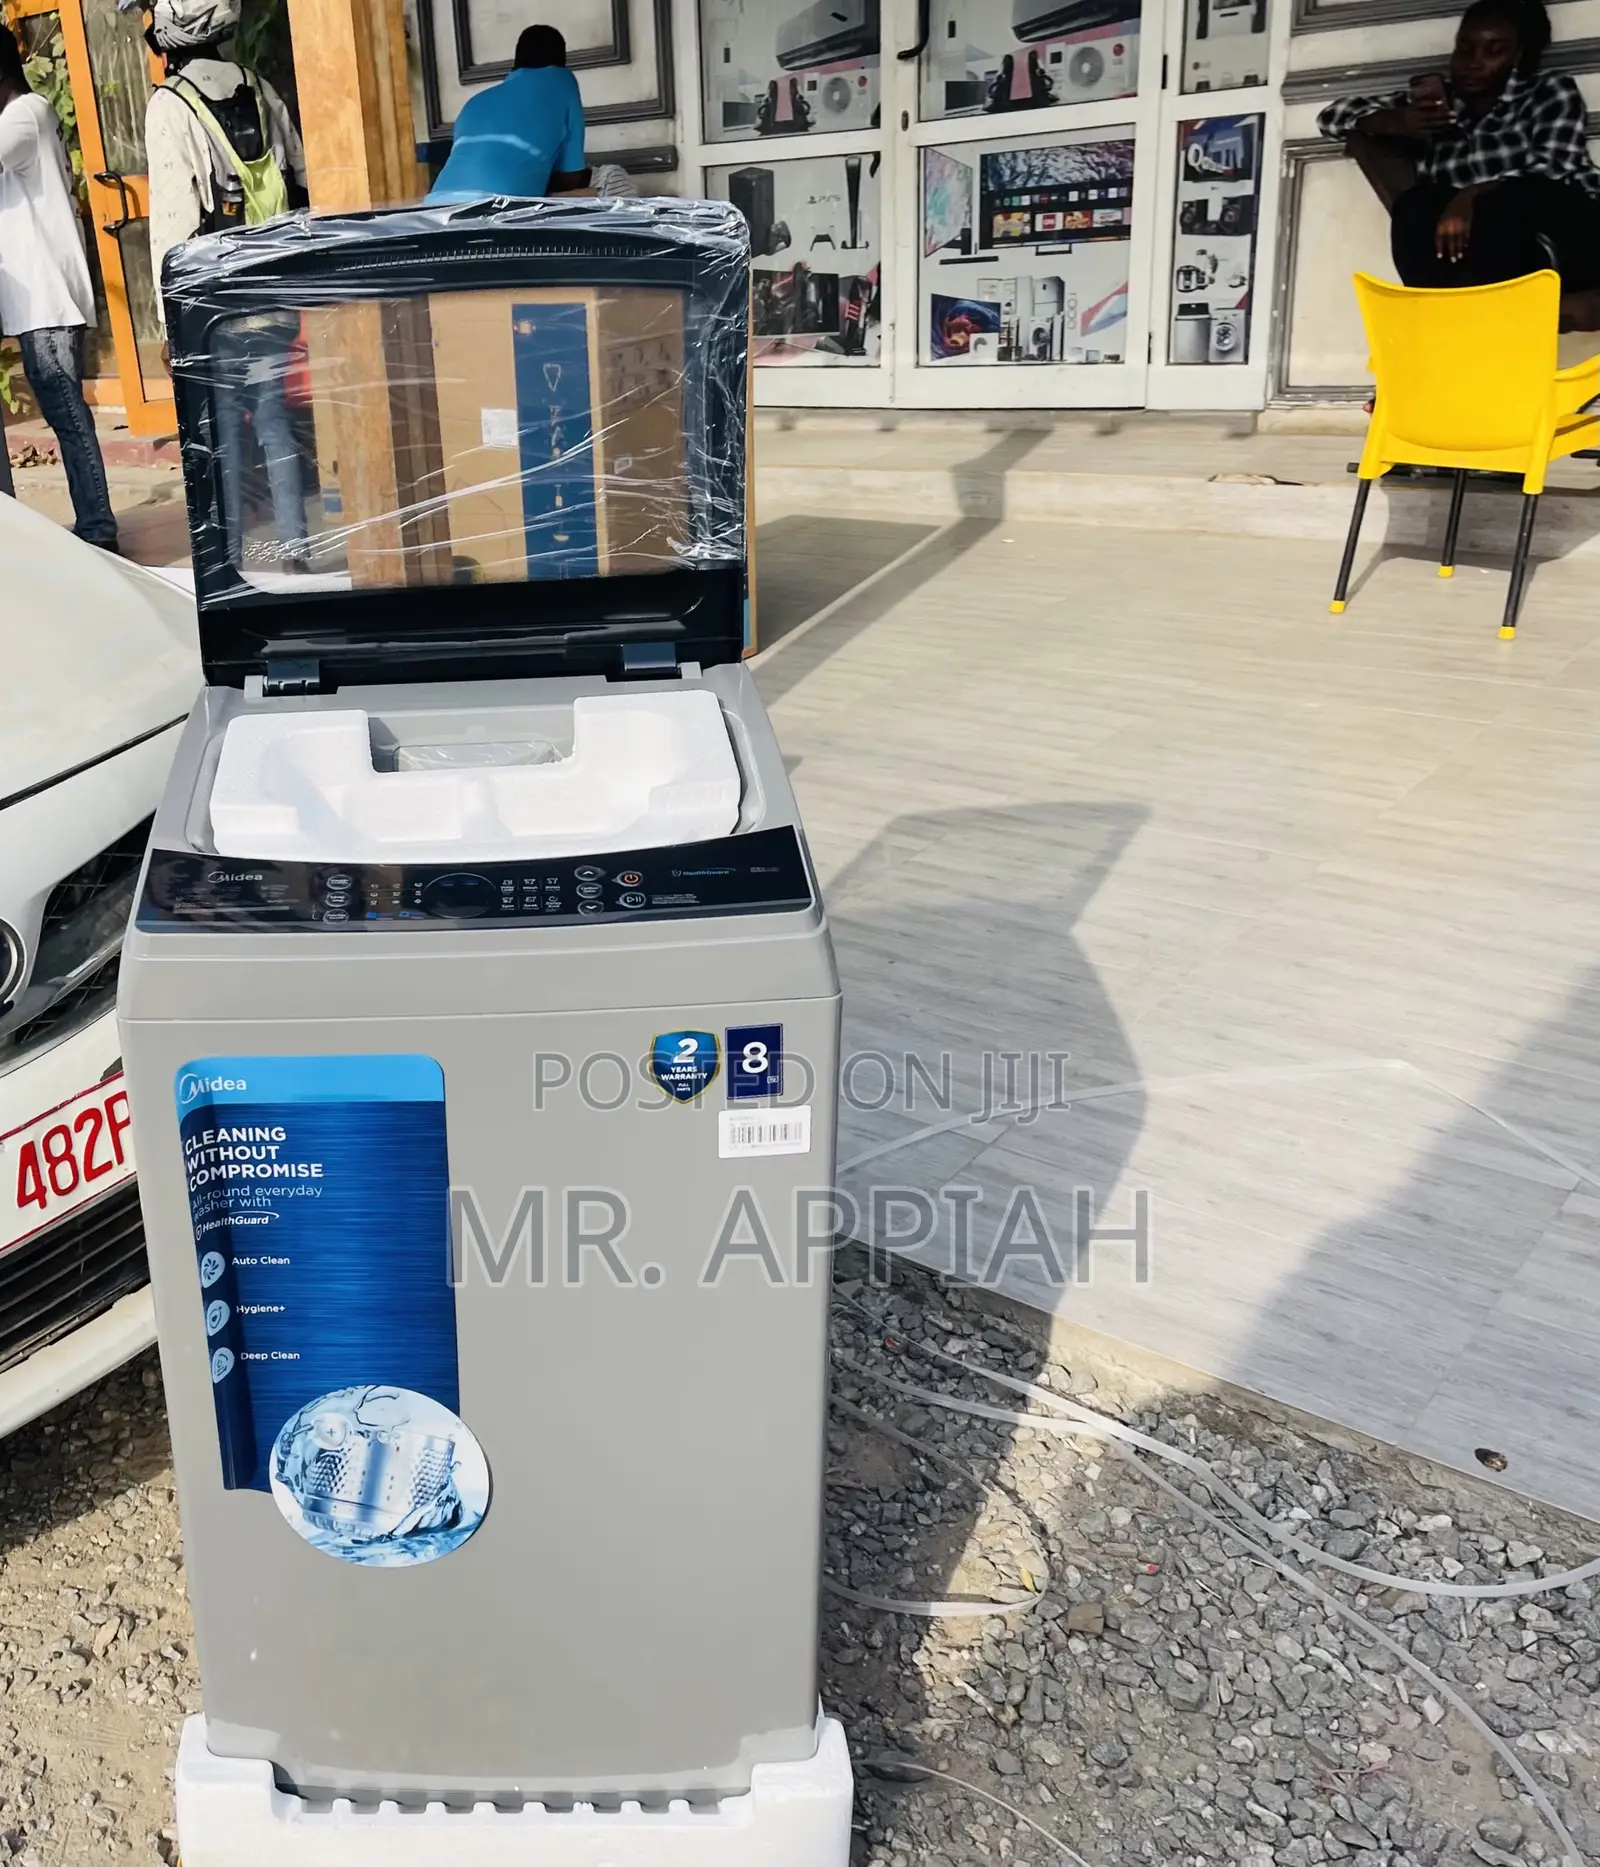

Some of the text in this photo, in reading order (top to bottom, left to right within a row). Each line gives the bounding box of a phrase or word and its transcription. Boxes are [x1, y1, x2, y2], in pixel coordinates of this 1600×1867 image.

[208, 871, 263, 884] Midea
[673, 1038, 699, 1063] 2
[742, 1041, 769, 1074] 8
[179, 1073, 247, 1104] Midea
[661, 1073, 708, 1081] WARRANTY
[185, 1126, 287, 1156] CLEANING
[187, 1145, 280, 1174] WITHOUT
[189, 1163, 324, 1193] COMPROMISE
[191, 1185, 323, 1212] All-round everyday
[193, 1196, 272, 1222] washer with
[202, 1215, 270, 1233] HealthGuard
[231, 1256, 290, 1265] Auto Clean
[236, 1304, 286, 1315] Hygiene+
[240, 1351, 300, 1361] Deep Clean
